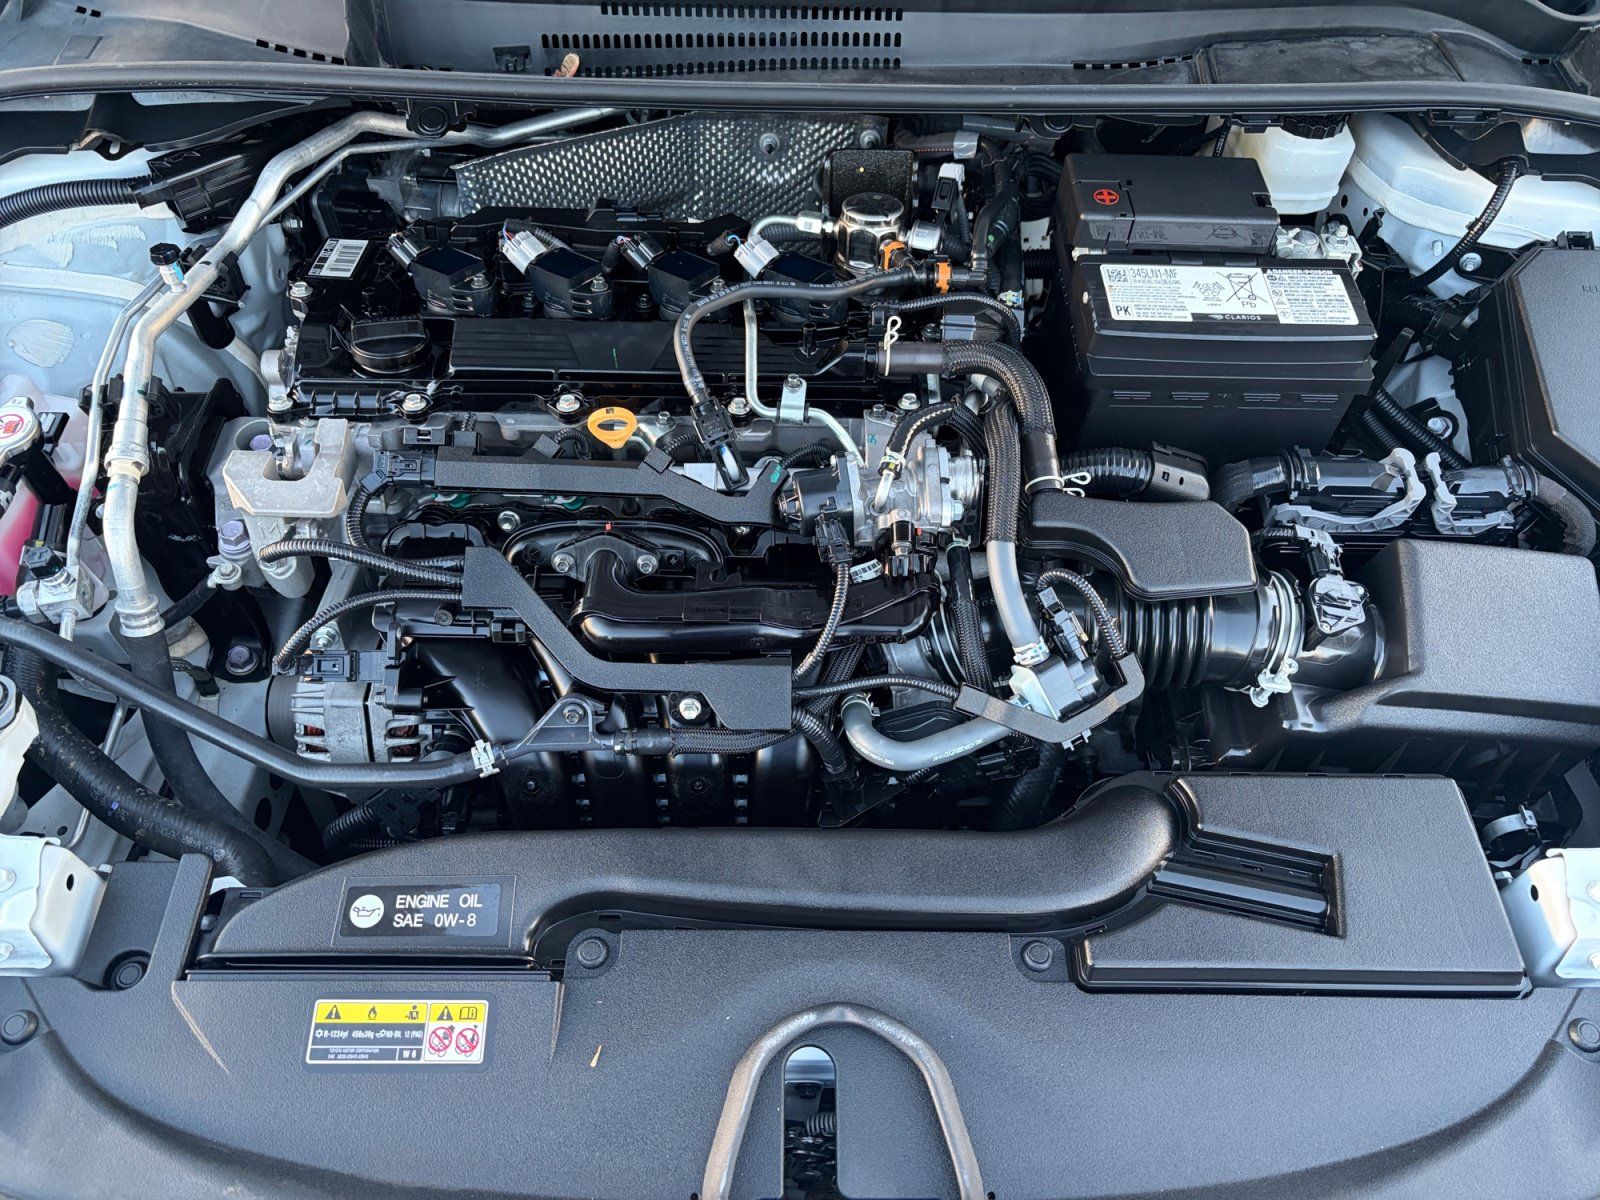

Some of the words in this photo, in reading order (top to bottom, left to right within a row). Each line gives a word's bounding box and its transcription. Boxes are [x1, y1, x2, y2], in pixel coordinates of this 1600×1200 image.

[1130, 268, 1178, 279] 345LN1-MF
[1115, 305, 1131, 316] PK
[395, 894, 450, 909] ENGINE
[458, 893, 483, 908] OIL
[392, 913, 424, 928] SAE
[434, 912, 477, 928] 0W-8
[402, 1050, 411, 1059] W
